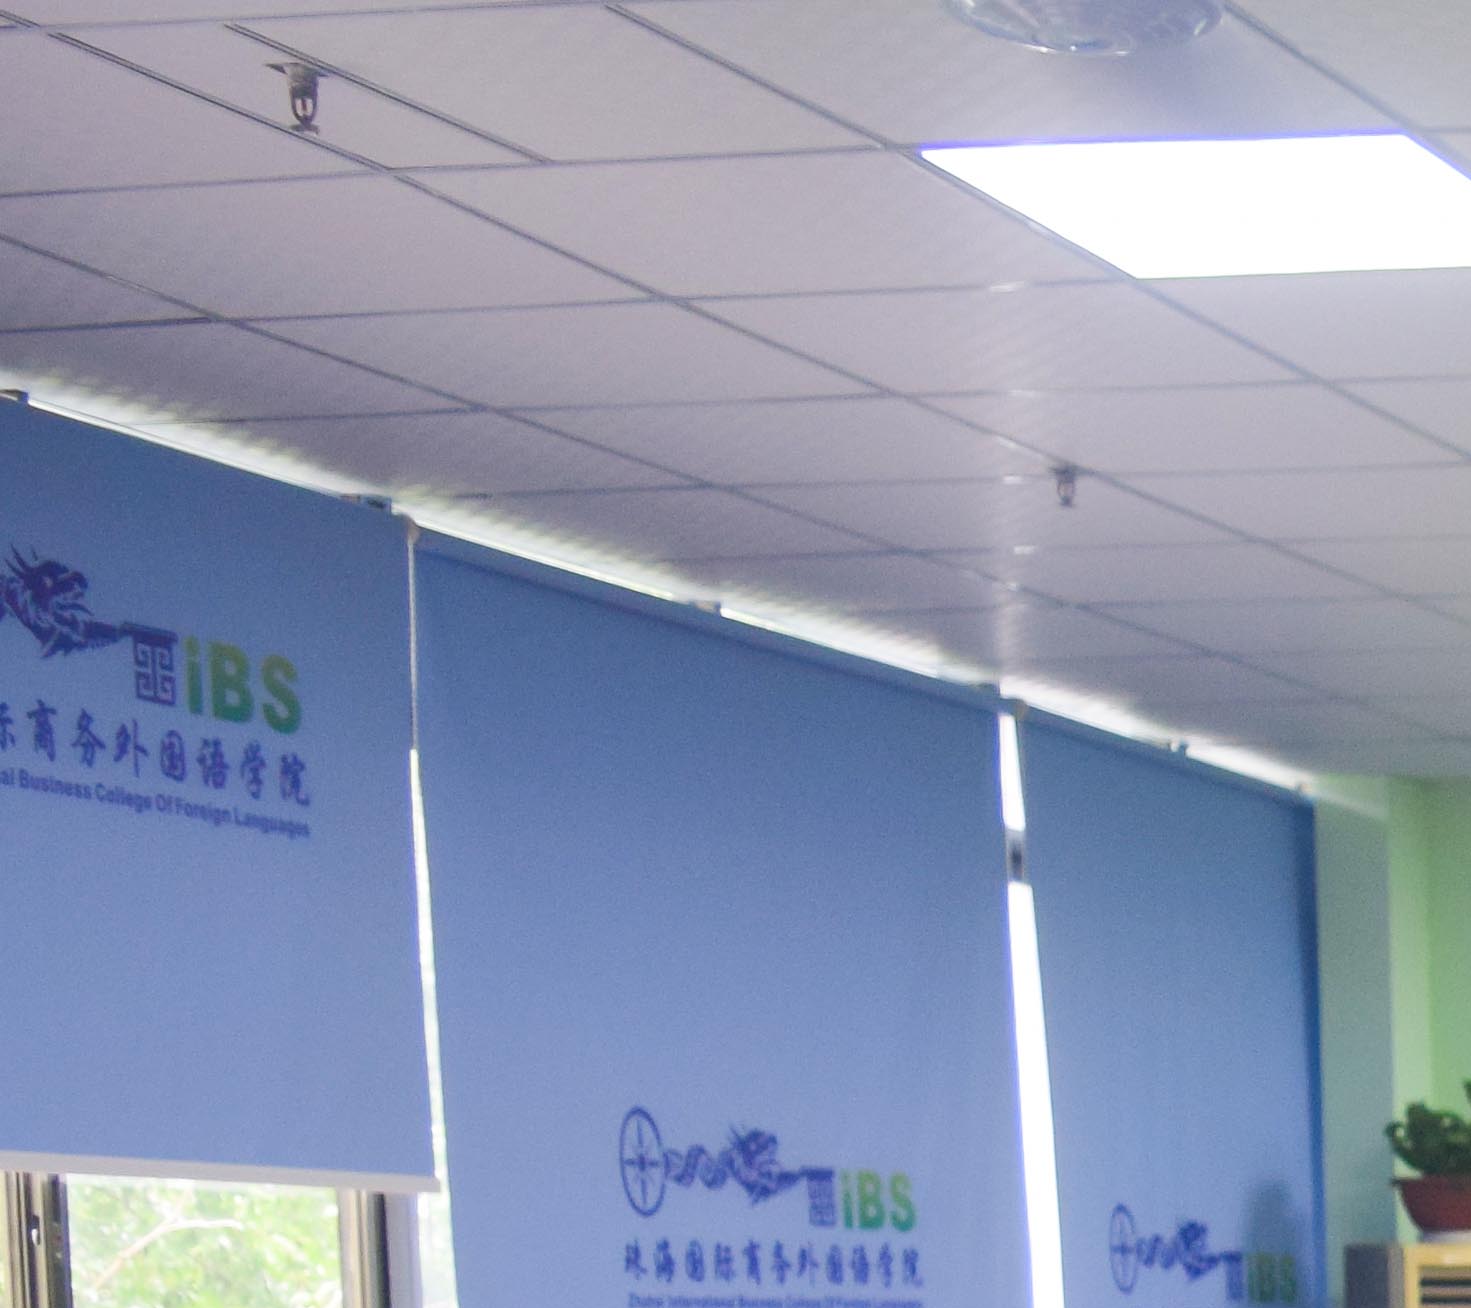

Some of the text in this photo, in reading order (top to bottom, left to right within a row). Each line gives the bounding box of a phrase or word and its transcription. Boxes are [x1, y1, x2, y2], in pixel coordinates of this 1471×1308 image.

[19, 768, 92, 800] Business
[95, 783, 151, 814] College
[175, 796, 231, 827] Foreign
